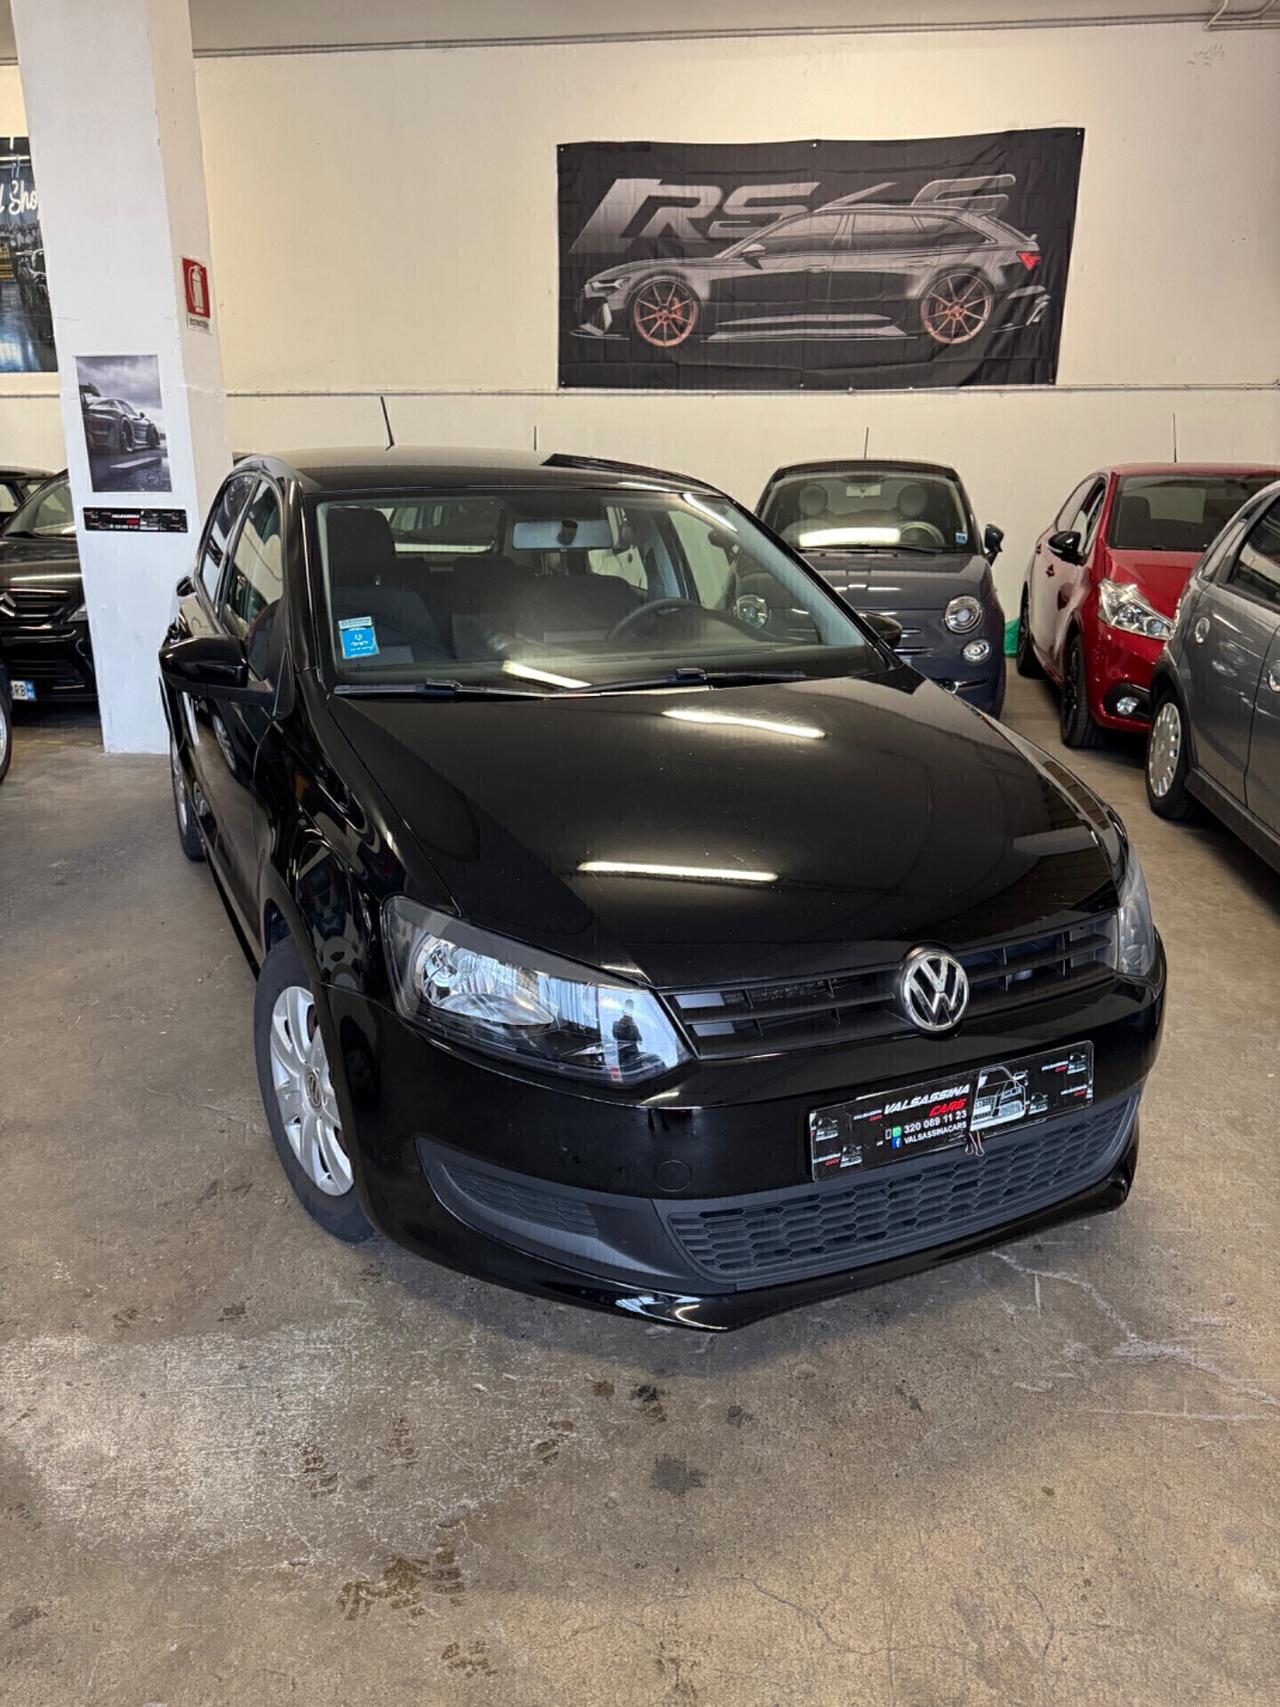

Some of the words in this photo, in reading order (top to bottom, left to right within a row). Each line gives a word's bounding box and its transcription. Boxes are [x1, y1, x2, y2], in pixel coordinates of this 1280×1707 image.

[9, 179, 40, 220] Sho
[884, 1084, 970, 1114] VALSASSINA
[929, 1098, 967, 1117] CARS
[904, 1122, 921, 1134] 320
[943, 1113, 953, 1123] 11
[955, 1109, 967, 1120] 23
[904, 1121, 967, 1144] VALSASSINACARS
